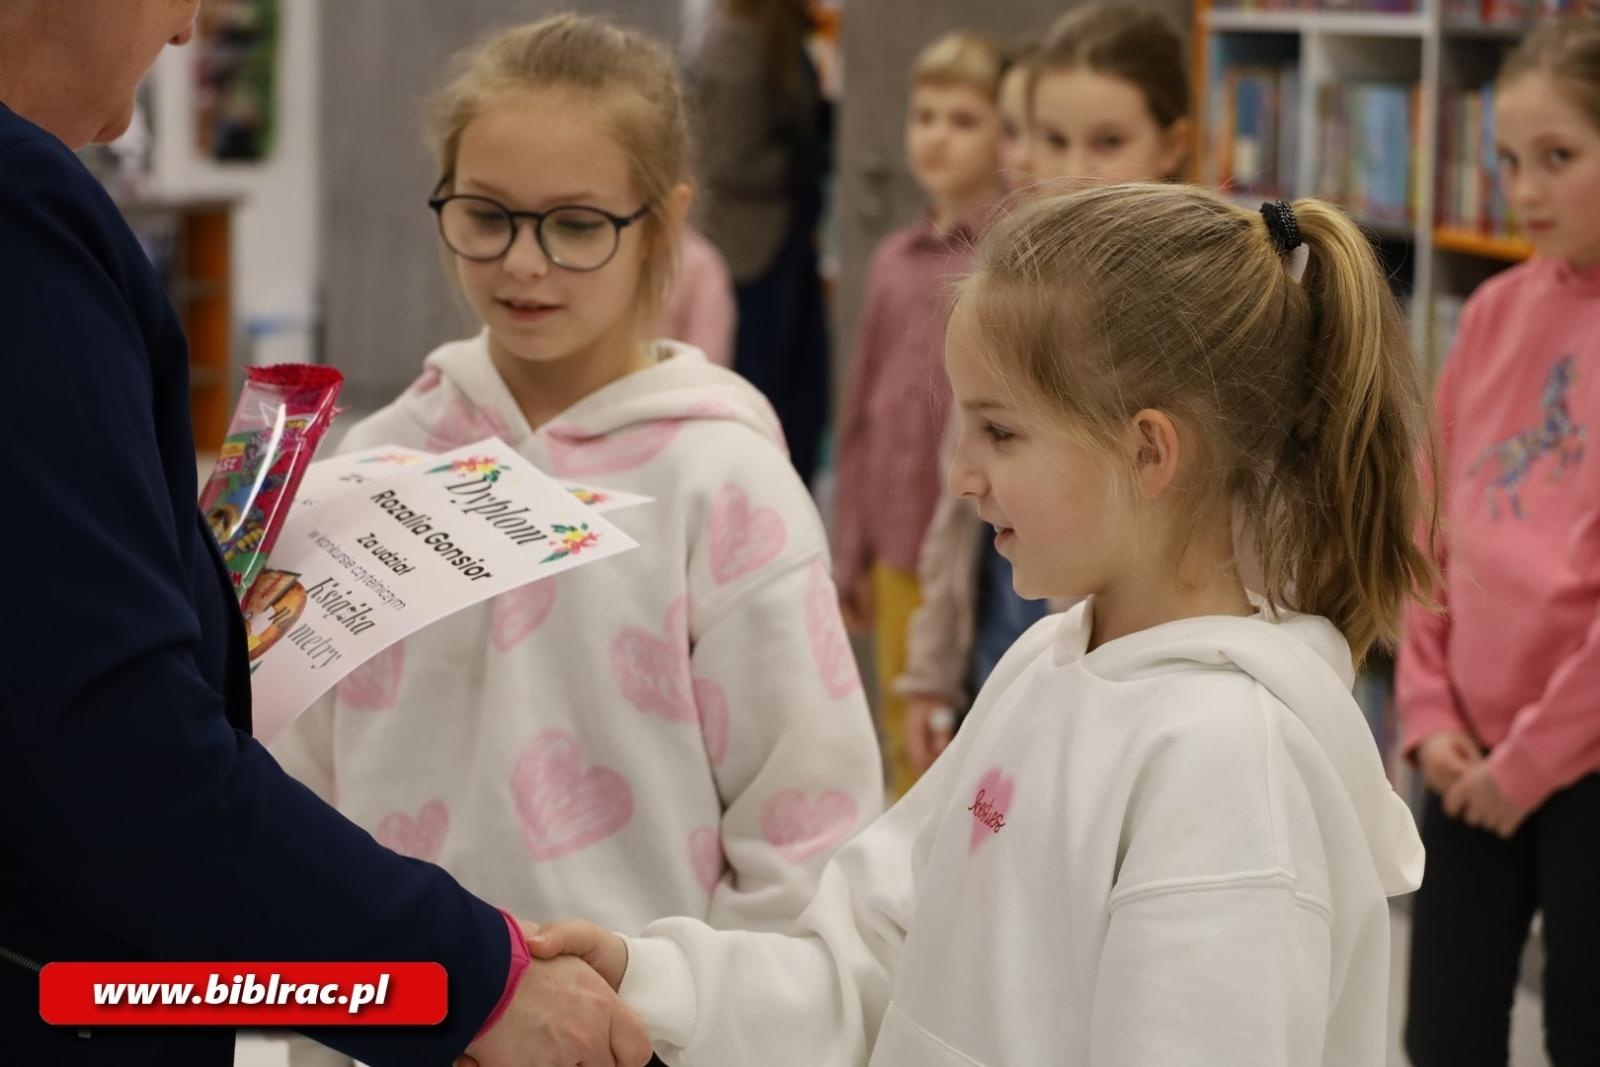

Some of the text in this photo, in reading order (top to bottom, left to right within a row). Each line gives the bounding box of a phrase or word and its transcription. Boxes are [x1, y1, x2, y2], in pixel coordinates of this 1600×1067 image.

[370, 489, 493, 581] Rozalia Gonsior
[444, 478, 548, 546] Dyplom
[357, 532, 416, 576] Za udział
[305, 577, 375, 636] Książka
[287, 623, 342, 669] metry
